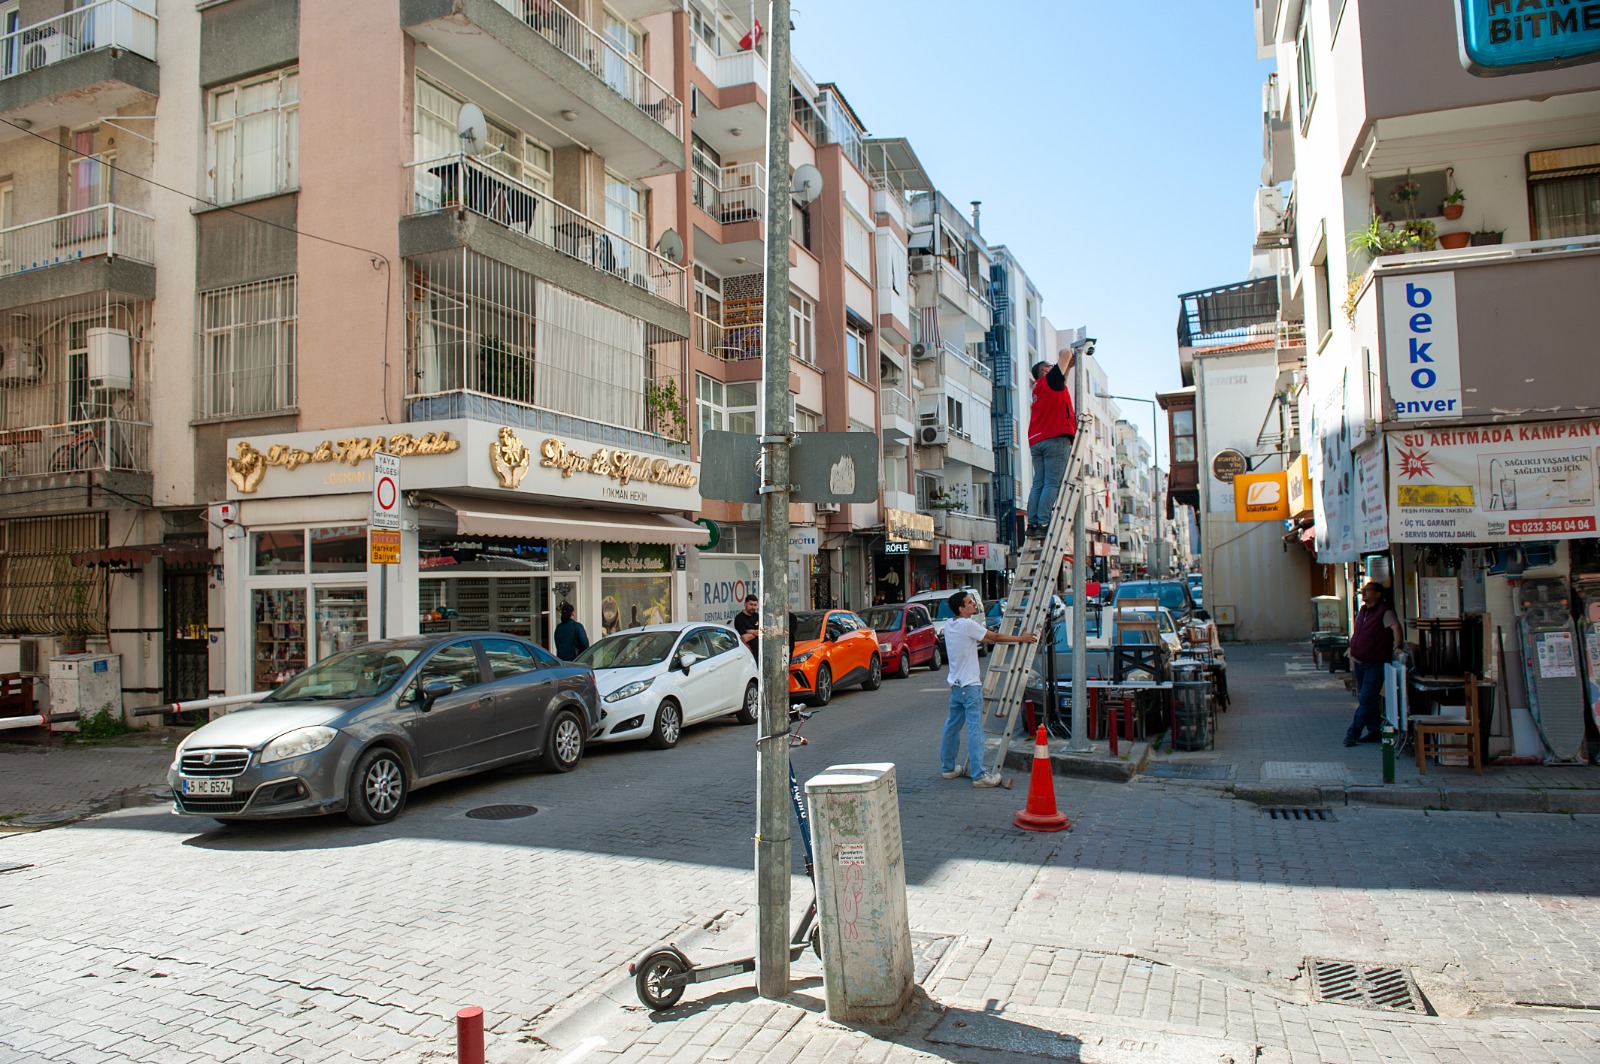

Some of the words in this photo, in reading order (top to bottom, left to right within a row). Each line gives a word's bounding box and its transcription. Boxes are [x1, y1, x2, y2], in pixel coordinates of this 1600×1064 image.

[1405, 282, 1437, 389] beko
[1396, 398, 1457, 414] enver
[1404, 433, 1425, 448] SU
[1430, 427, 1514, 447] ARITMADA
[378, 456, 396, 467] YAYA
[1504, 457, 1541, 467] SAĞLIKLI
[1542, 455, 1570, 464] YAŞAM
[1513, 465, 1550, 475] SAĞLIKLI
[1552, 465, 1563, 473] SU
[1404, 518, 1414, 528] ÜÇ
[1415, 519, 1426, 527] YIL
[1426, 517, 1456, 527] GARANTİ
[1521, 521, 1544, 533] 0232
[1546, 520, 1562, 532] 364
[1563, 520, 1576, 531] 04
[1577, 519, 1590, 530] 04
[1404, 530, 1428, 538] SERVİS
[1428, 531, 1456, 539] MONTAJ
[1457, 529, 1477, 538] DAHİL
[978, 546, 986, 556] E
[704, 579, 760, 604] RADYOTE
[210, 782, 231, 793] 6524
